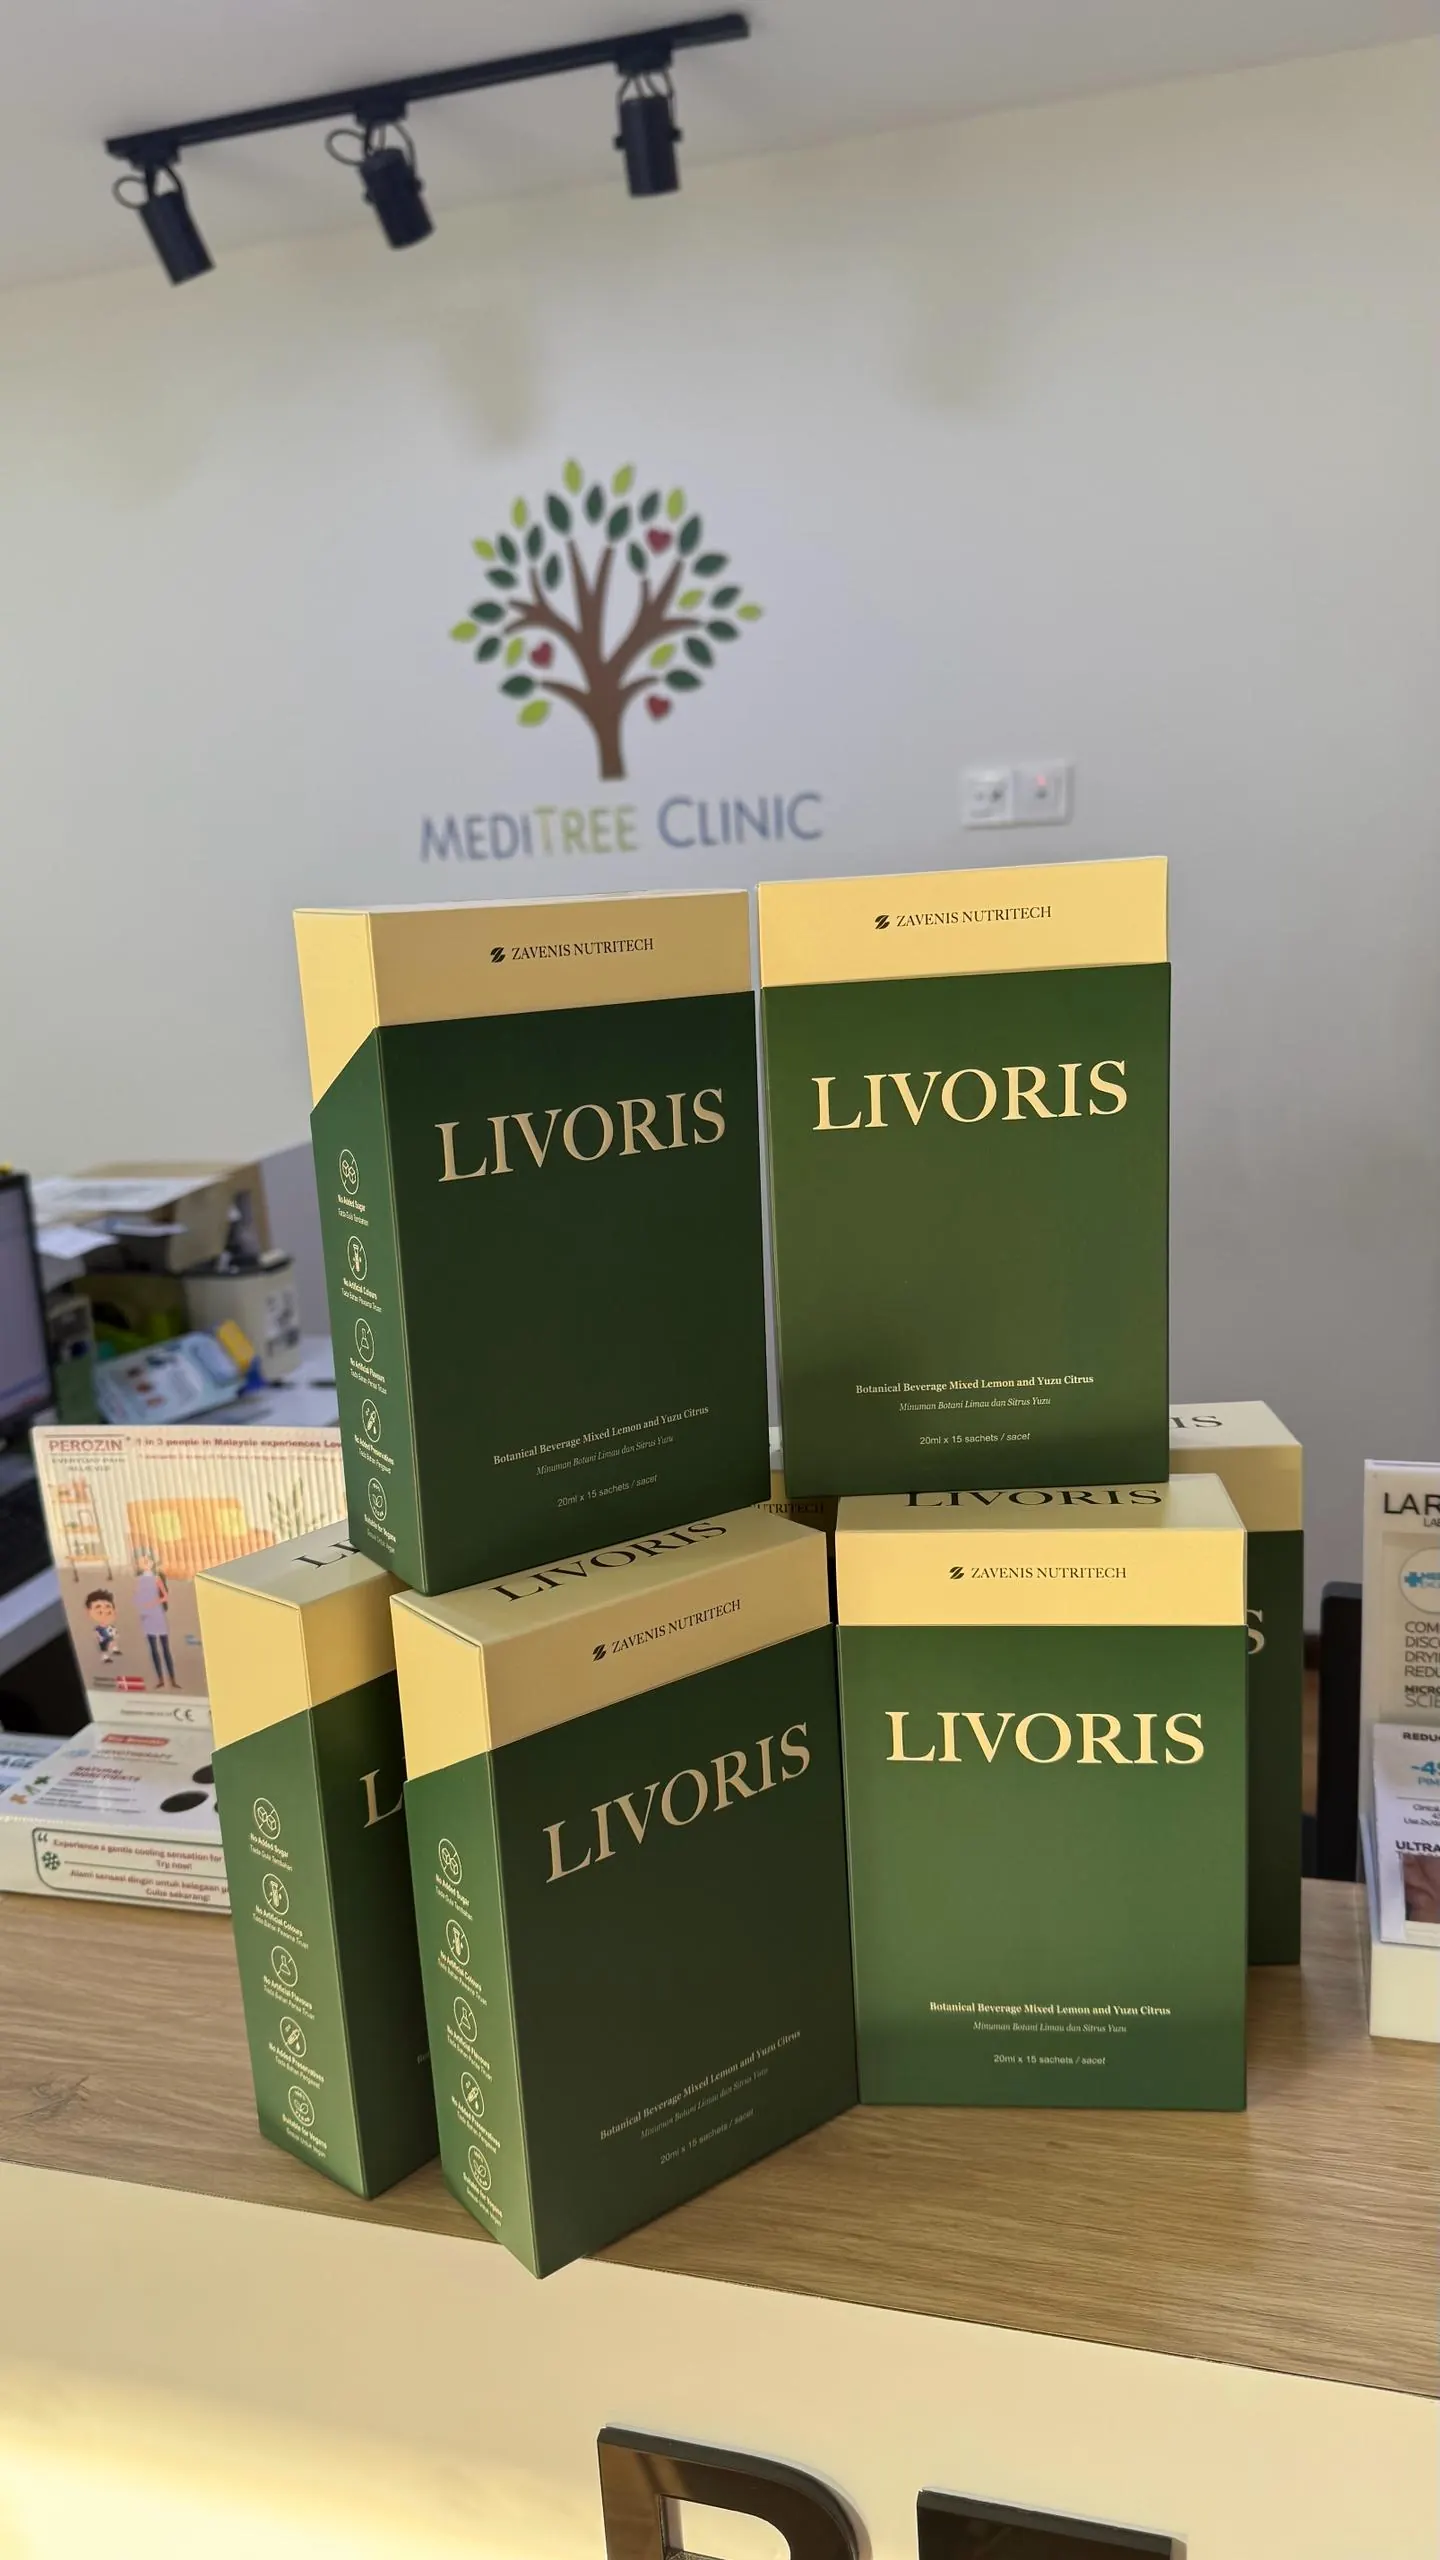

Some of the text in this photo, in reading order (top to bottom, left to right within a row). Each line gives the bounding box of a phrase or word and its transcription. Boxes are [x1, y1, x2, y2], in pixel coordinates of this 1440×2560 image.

[419, 792, 825, 863] MEDITREE CLINIC
[896, 905, 1052, 927] ZAVENIS NUTRITECH
[511, 938, 654, 960] ZAVENIS NUTRITECH
[811, 1061, 1128, 1130] LIVORIS
[434, 1089, 726, 1181] LIVORIS
[856, 1374, 1094, 1394] Botanical Beverage Mixed Lemon and Yuzu Citrus
[898, 1396, 1051, 1412] Minuman Botani Limau dan Sitrus Yuzu
[49, 1439, 123, 1453] PEROZIN
[166, 1438, 200, 1448] people
[214, 1438, 259, 1448] Malaysia
[493, 1406, 709, 1465] Botanical Beverage Mixed Lemon and Yuzu Citrus
[919, 1436, 942, 1445] 20ml
[951, 1434, 963, 1444] 15
[964, 1433, 999, 1443] sachets
[1000, 1432, 1006, 1441] /
[1006, 1432, 1031, 1441] sacet
[556, 1494, 578, 1508] 20ml
[579, 1494, 585, 1502] x
[587, 1488, 598, 1499] 15
[598, 1482, 630, 1497] sachets
[630, 1479, 636, 1489] /
[904, 1489, 1164, 1507] LIVORIS
[488, 1521, 727, 1602] LIVORIS
[971, 1567, 1127, 1579] ZAVENIS NUTRITECH
[611, 1599, 741, 1654] ZAVENIS NUTRITECH
[884, 1711, 1205, 1764] LIVORIS
[542, 1724, 810, 1881] LIVORIS
[929, 2001, 1172, 2016] Botanical Beverage Mixed Lemon and Yuzu Citrus
[993, 2054, 1016, 2063] 20ml
[1017, 2056, 1024, 2064] x
[1026, 2055, 1037, 2064] 15
[1038, 2056, 1074, 2065] sachets
[1075, 2056, 1081, 2064] /
[600, 2031, 801, 2140] Botanical Beverage Mixed Lemon and Yuzu Citrus
